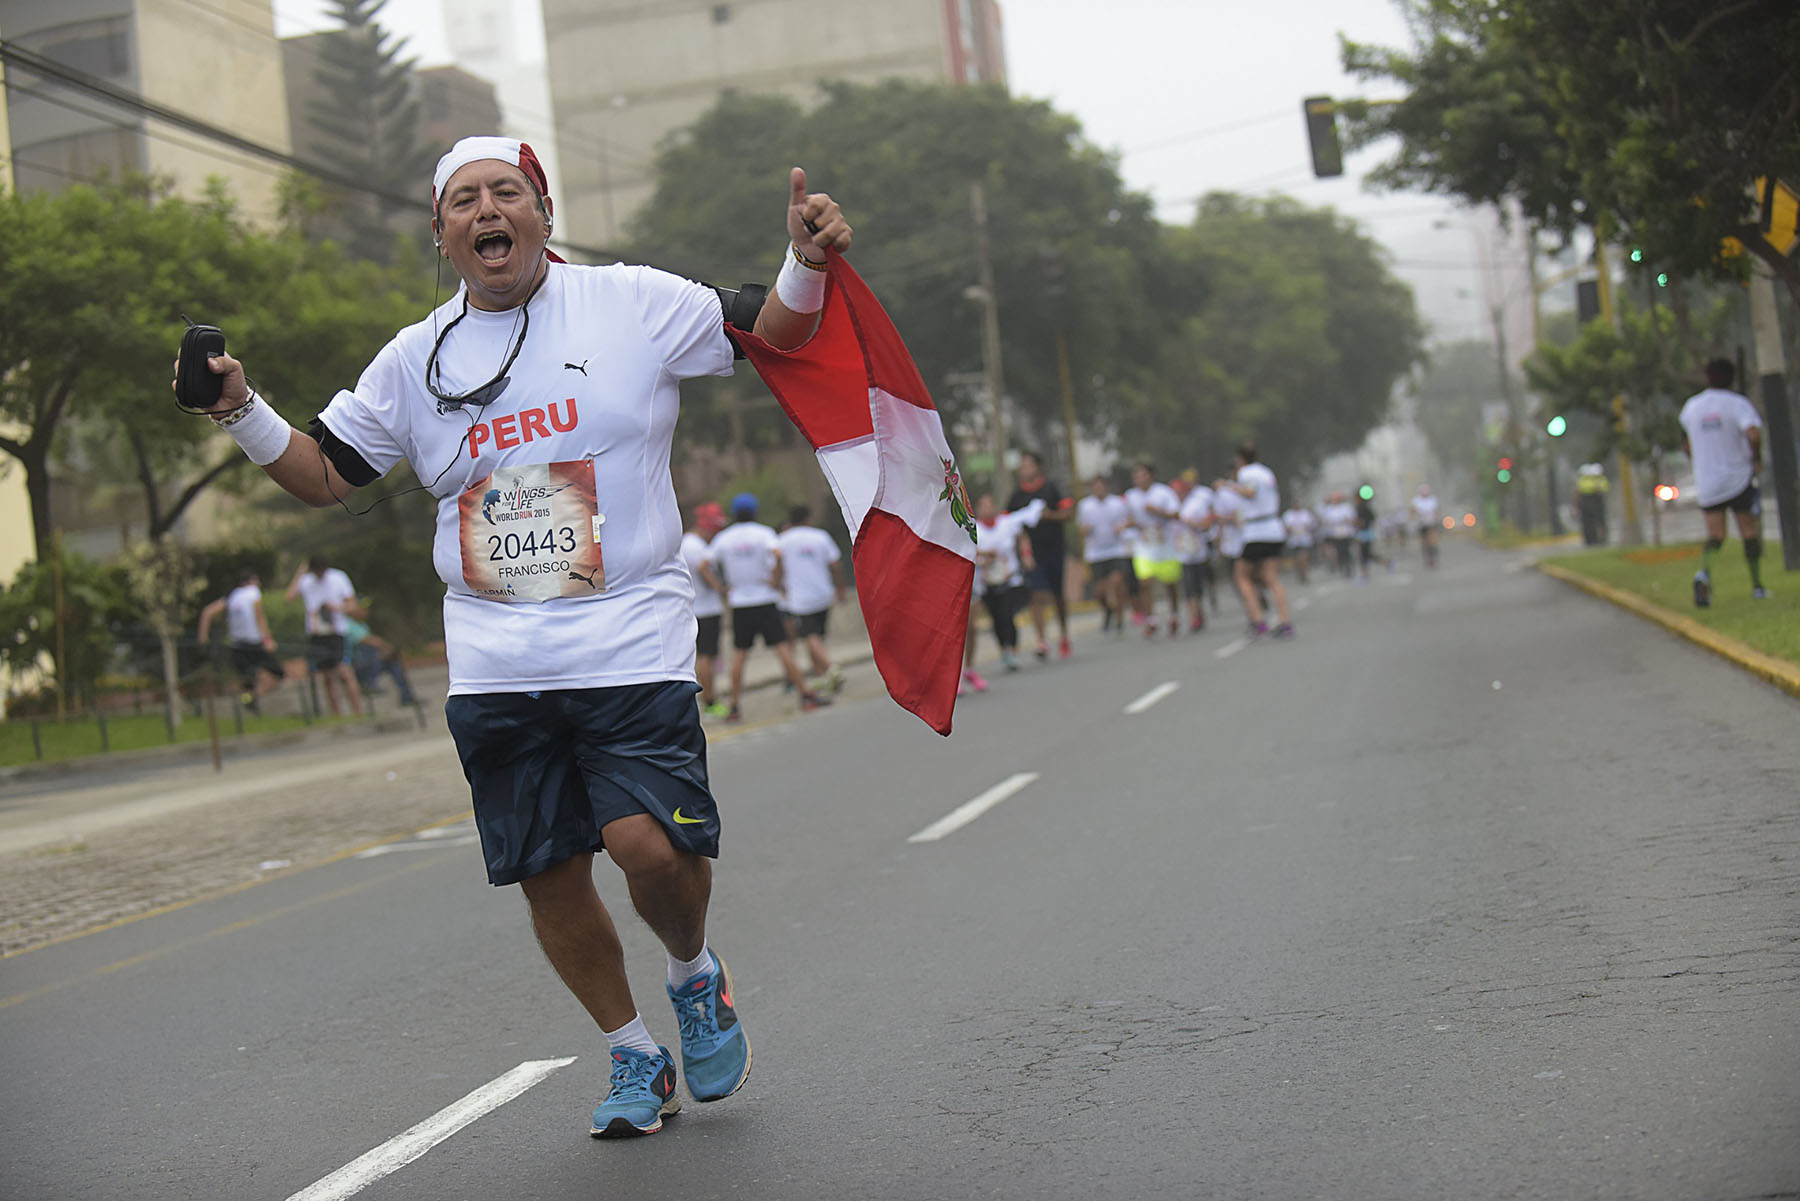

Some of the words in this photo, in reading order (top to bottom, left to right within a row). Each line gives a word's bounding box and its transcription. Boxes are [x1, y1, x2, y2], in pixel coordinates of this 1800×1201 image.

[467, 398, 578, 459] PERU
[503, 487, 546, 501] WINGS
[511, 499, 535, 510] LIFE
[534, 508, 550, 518] 2015
[487, 527, 577, 562] 20443
[498, 560, 570, 579] FRANCISCO
